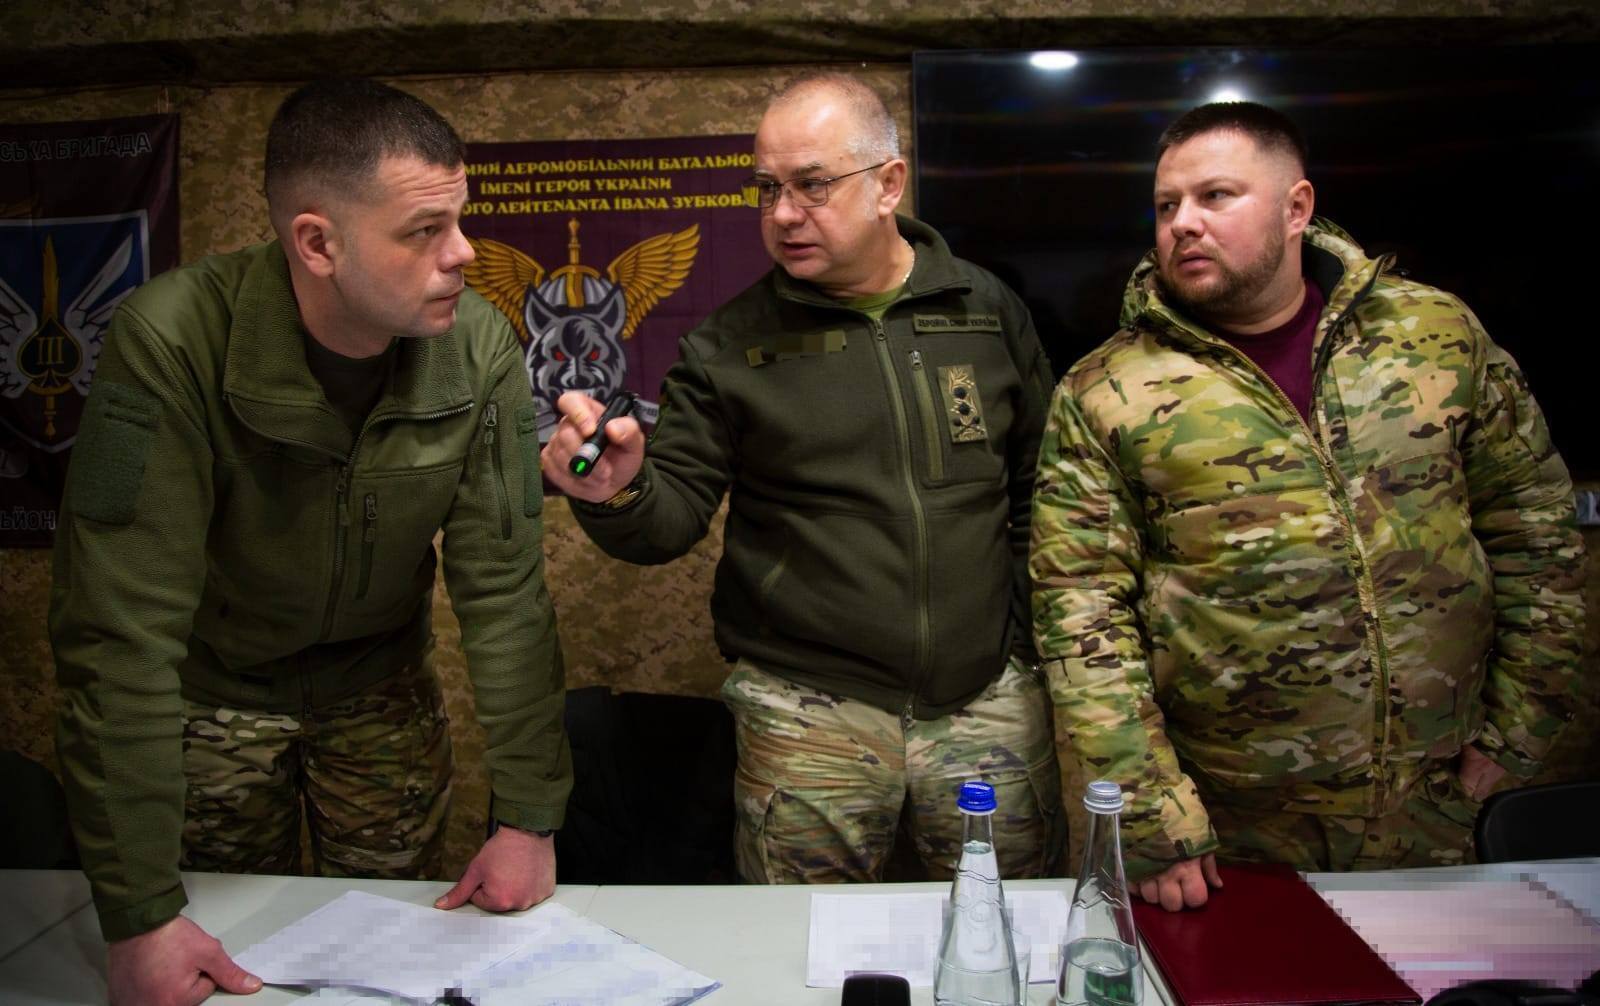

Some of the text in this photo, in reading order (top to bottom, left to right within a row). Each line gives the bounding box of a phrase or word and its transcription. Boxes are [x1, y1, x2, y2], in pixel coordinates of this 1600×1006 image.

[55, 132, 152, 160] БРИГАДА
[504, 157, 654, 175] АЕРОМОБІЛЬНИЙ
[535, 178, 591, 193] ГЕРОЯ
[595, 176, 672, 191] УКРАЇНИ
